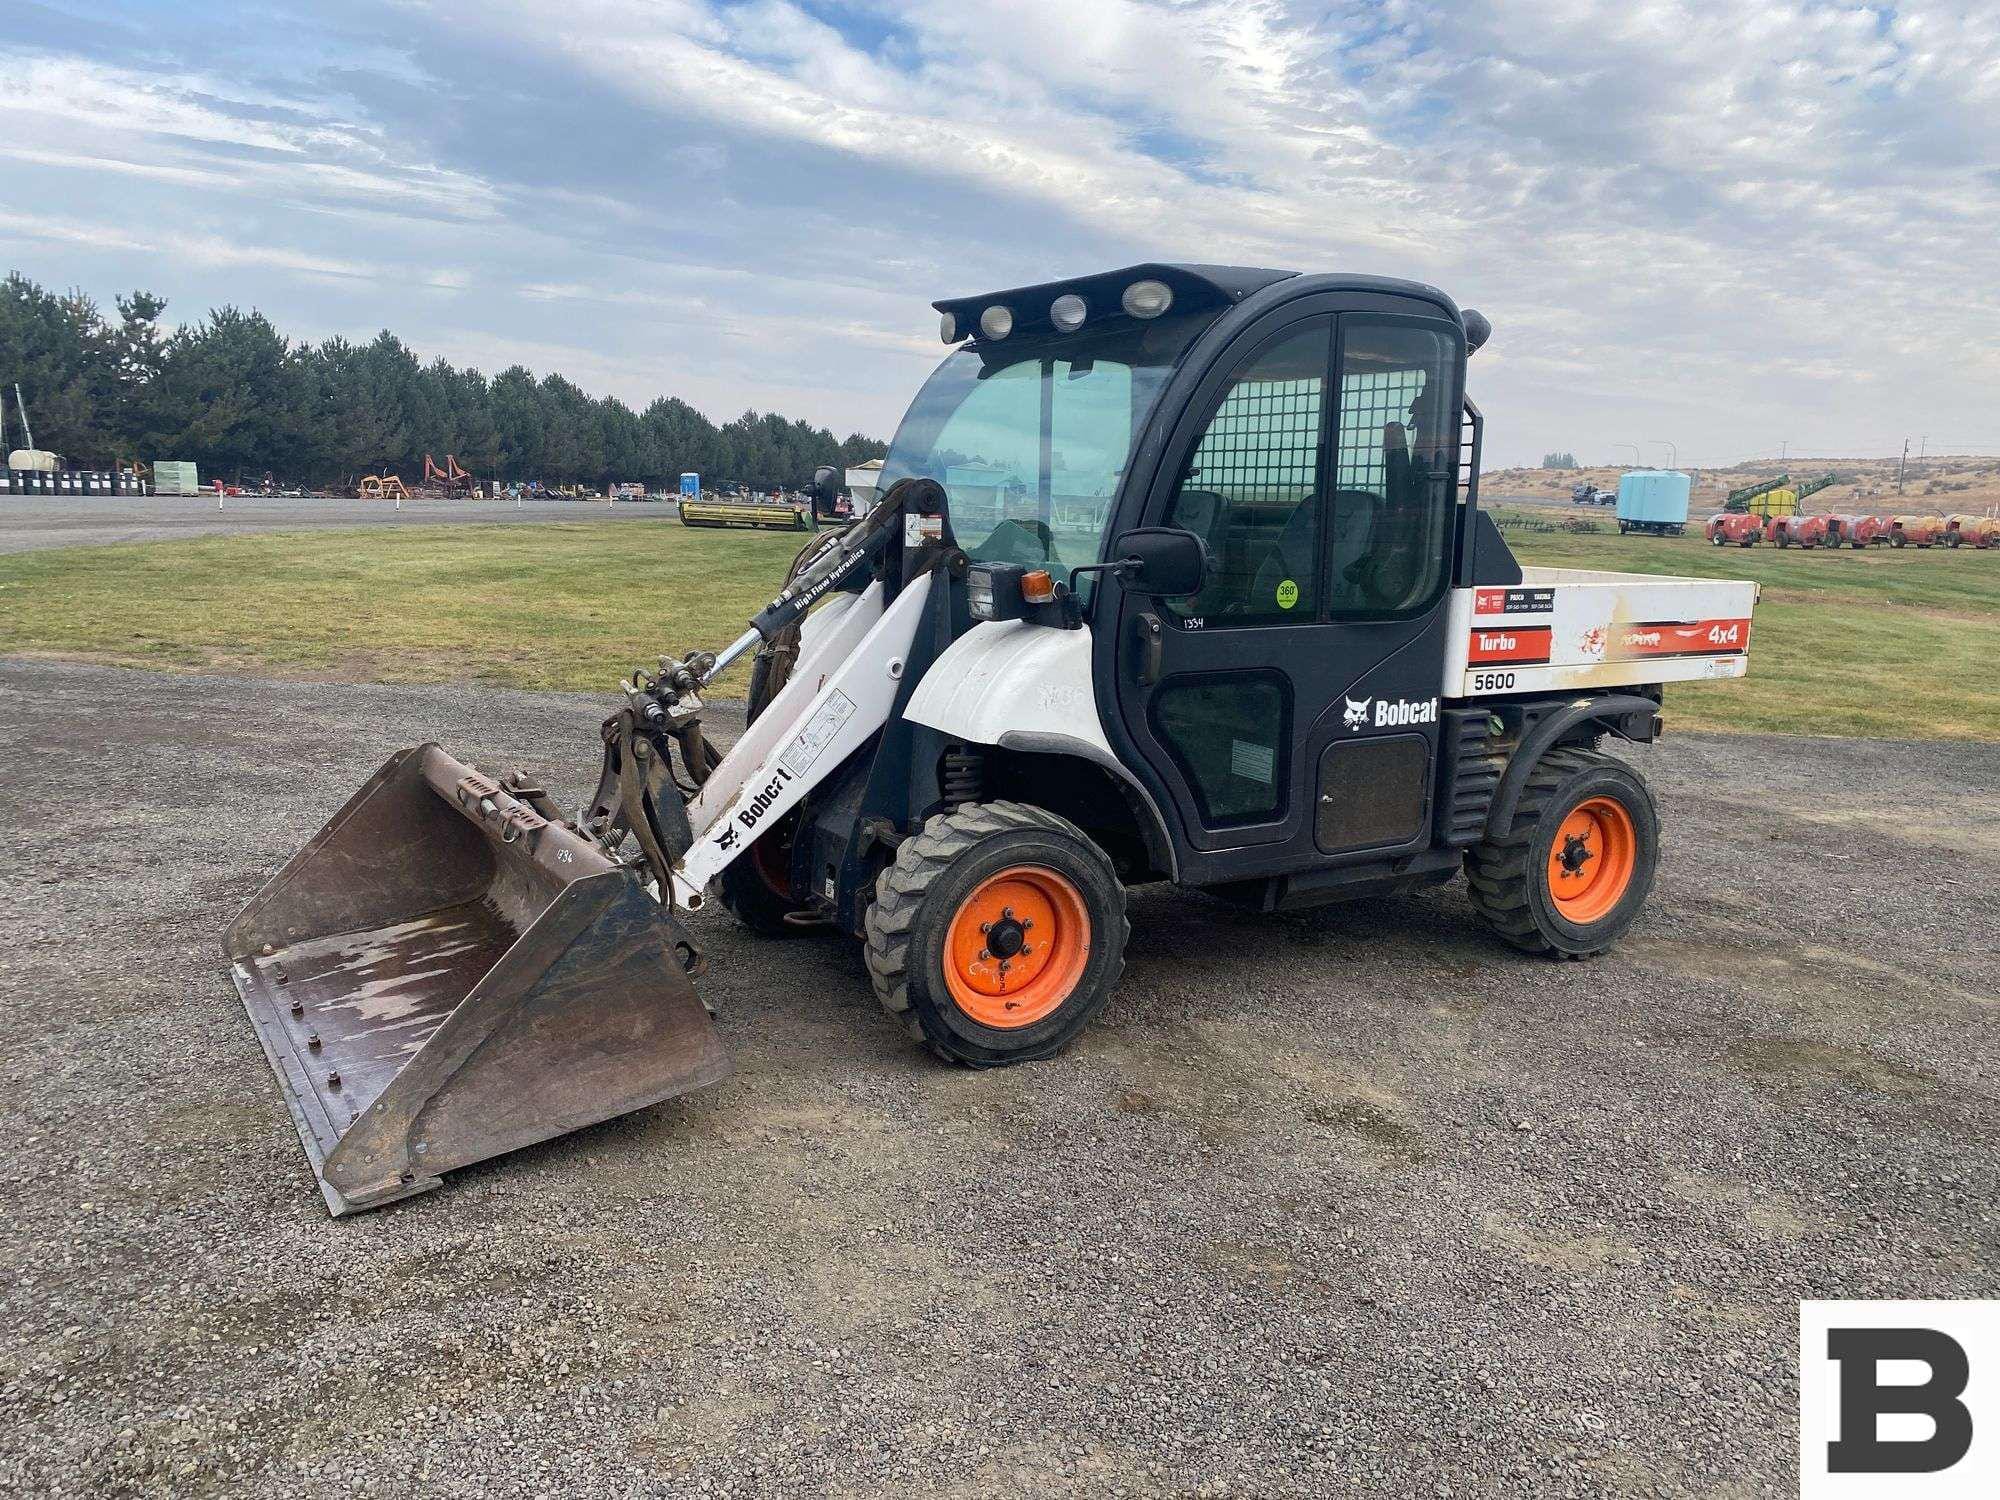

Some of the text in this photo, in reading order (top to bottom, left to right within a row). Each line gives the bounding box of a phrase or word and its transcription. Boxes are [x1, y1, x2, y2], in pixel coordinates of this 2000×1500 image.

[794, 548, 865, 610] High Flow Hydraulics
[1479, 633, 1517, 651] Turbo
[1708, 624, 1738, 644] 4x4
[1474, 672, 1516, 691] 5600
[1375, 697, 1438, 727] Bobcat
